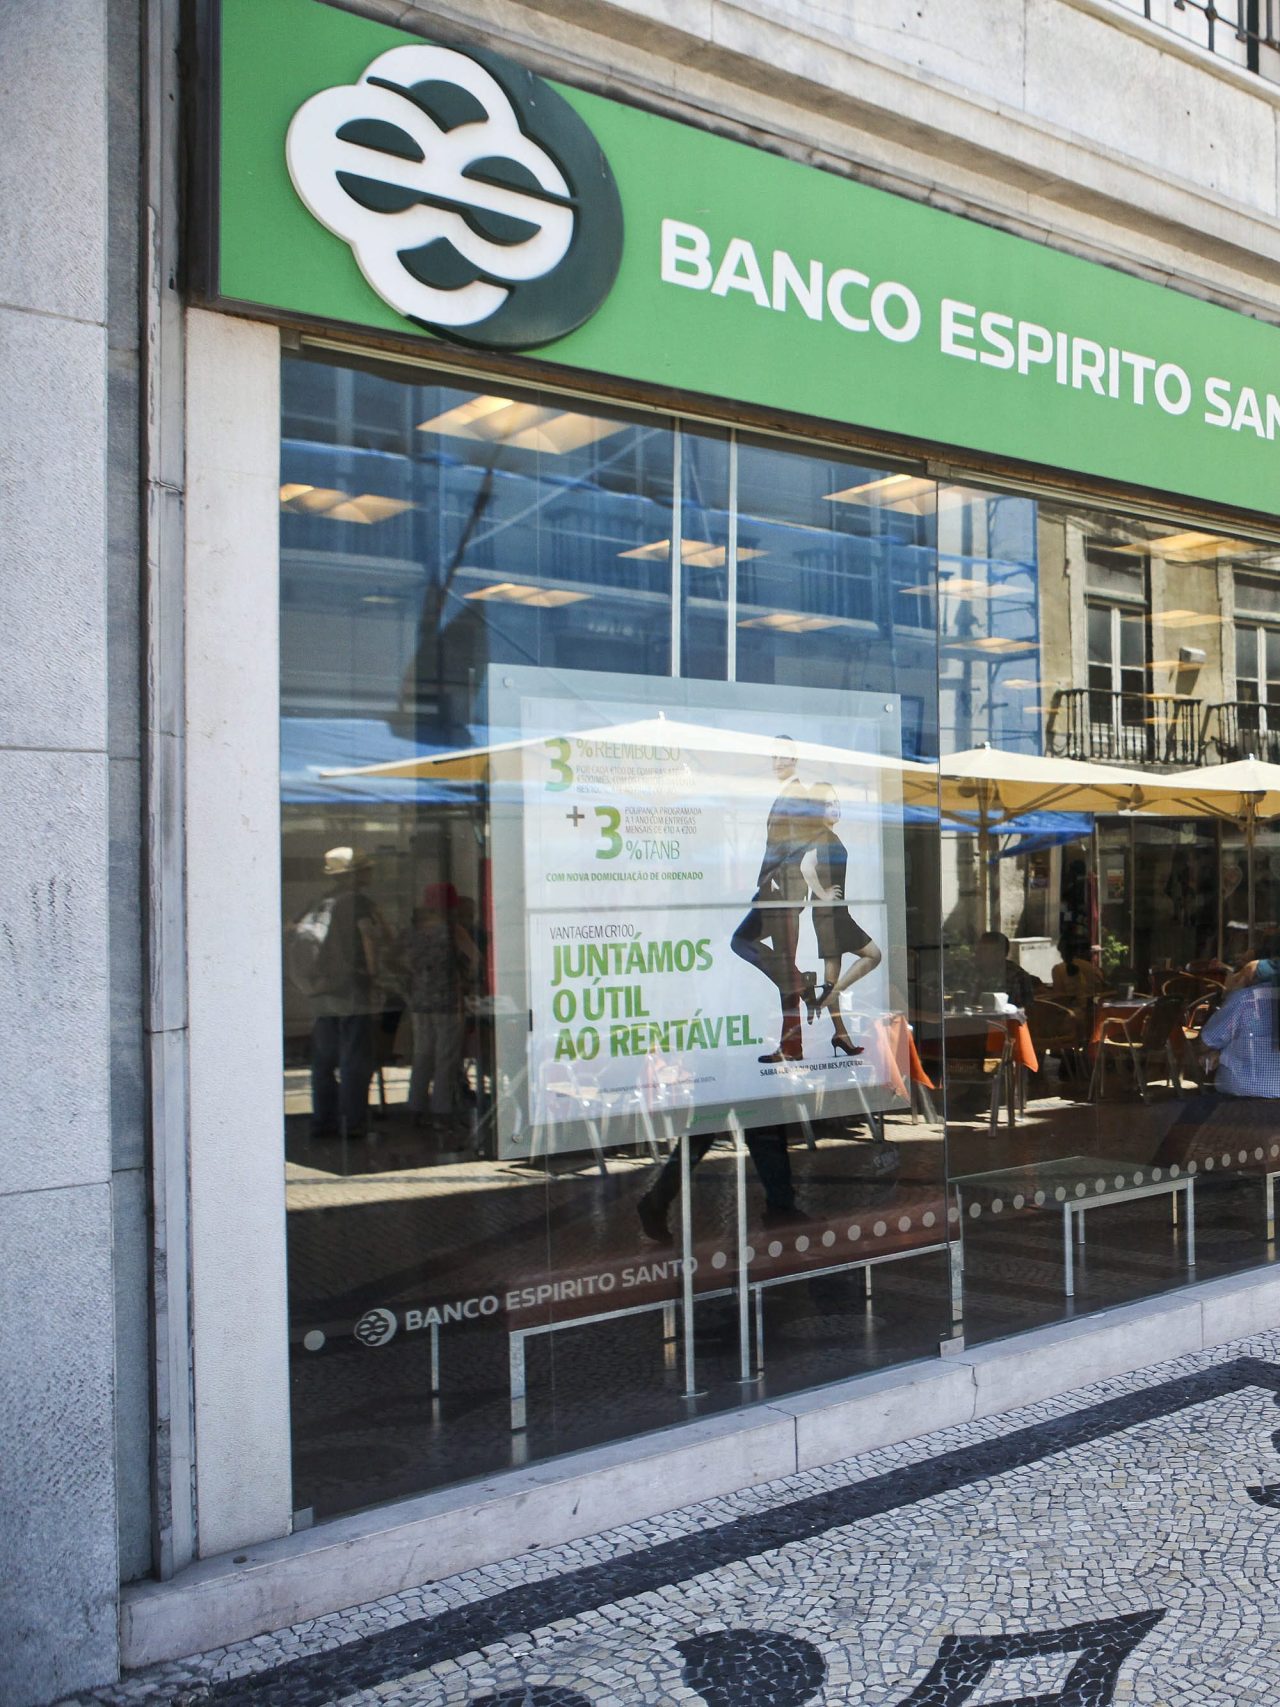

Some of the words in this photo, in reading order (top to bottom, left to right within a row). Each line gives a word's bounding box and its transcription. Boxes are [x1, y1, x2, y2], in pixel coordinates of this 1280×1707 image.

[661, 218, 921, 342] BANCO
[940, 298, 1191, 415] ESPIRITO
[544, 737, 574, 792] 3
[594, 805, 623, 859] 3
[546, 872, 565, 882] COM
[567, 872, 589, 882] NOVA
[591, 870, 648, 882] DOMICILIAÇÃO
[650, 872, 660, 881] DE
[662, 871, 704, 880] ORDENADO
[550, 925, 603, 940] VANTAGEM
[604, 924, 635, 938] CR100
[550, 932, 713, 986] JUNTÁMOS
[553, 988, 577, 1023] O
[583, 977, 650, 1021] ÚTIL
[554, 1025, 600, 1062] AO
[610, 1008, 763, 1057] RENTÁVEL.
[405, 1295, 499, 1331] BANCO
[506, 1273, 616, 1311] ESPIRITO
[622, 1257, 698, 1288] SANTO
